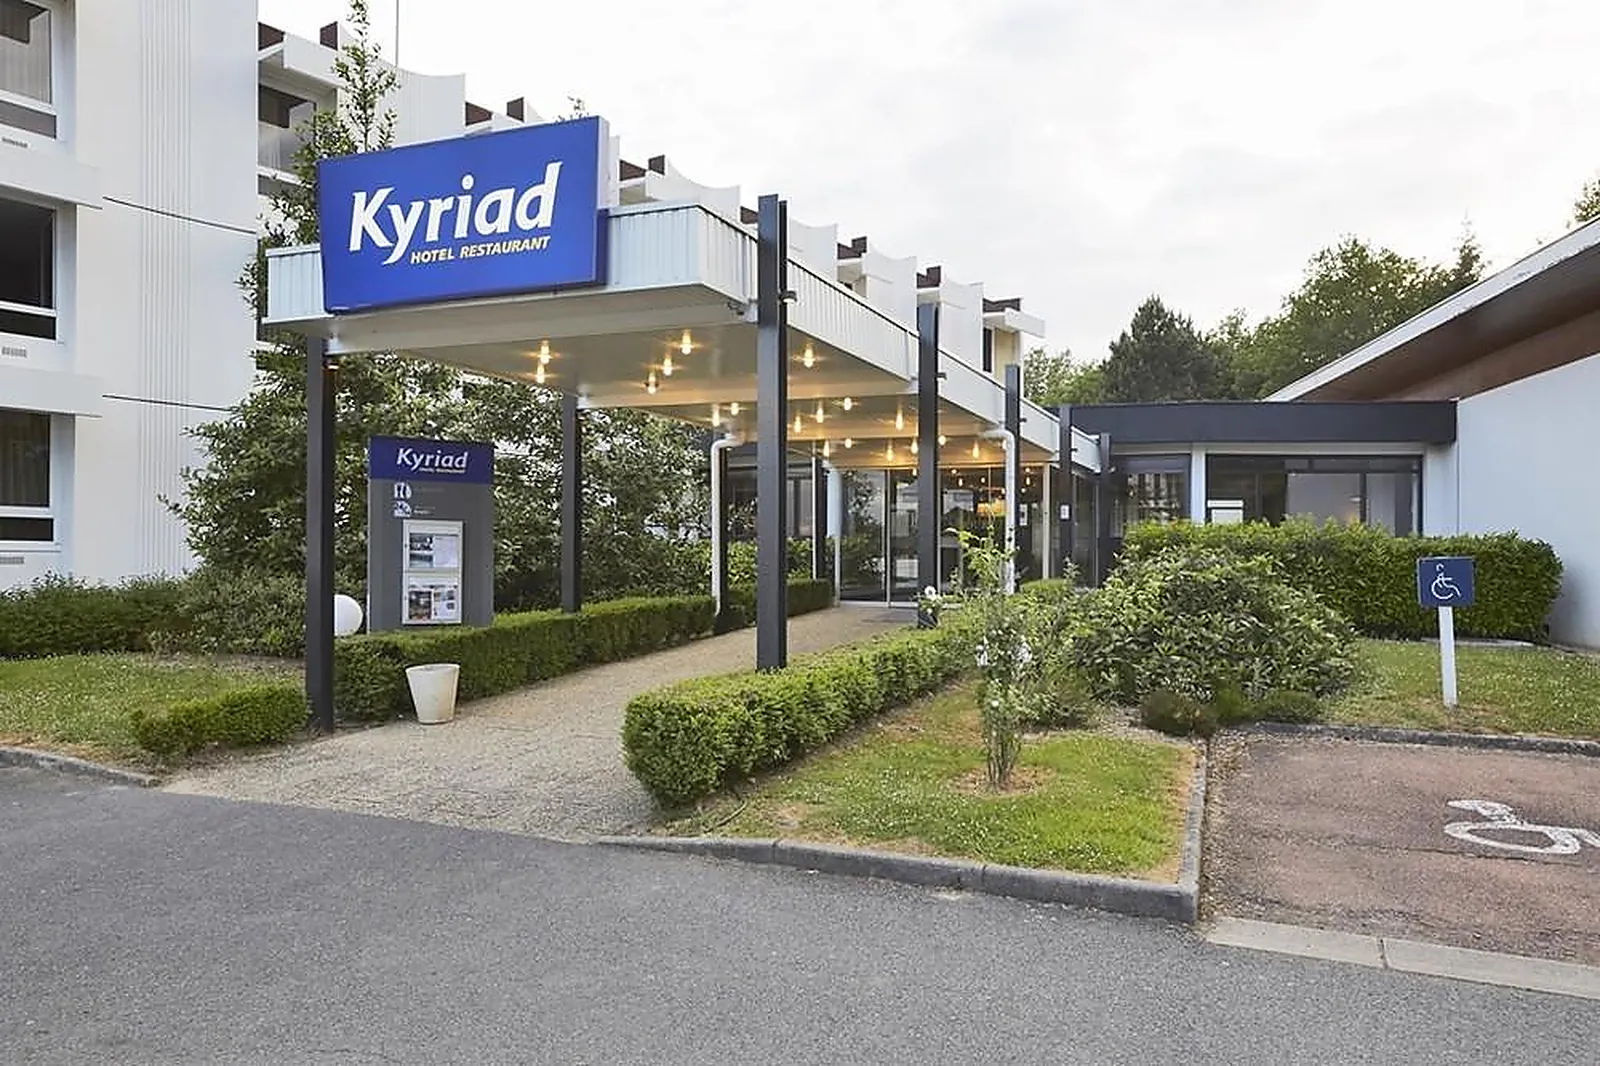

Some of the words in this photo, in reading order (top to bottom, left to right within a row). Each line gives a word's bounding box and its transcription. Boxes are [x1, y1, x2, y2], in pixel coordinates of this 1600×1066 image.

[350, 161, 563, 265] Kyriad
[410, 248, 455, 264] HOTEL
[460, 236, 551, 258] RESTAURANT
[396, 447, 469, 472] Kyriad
